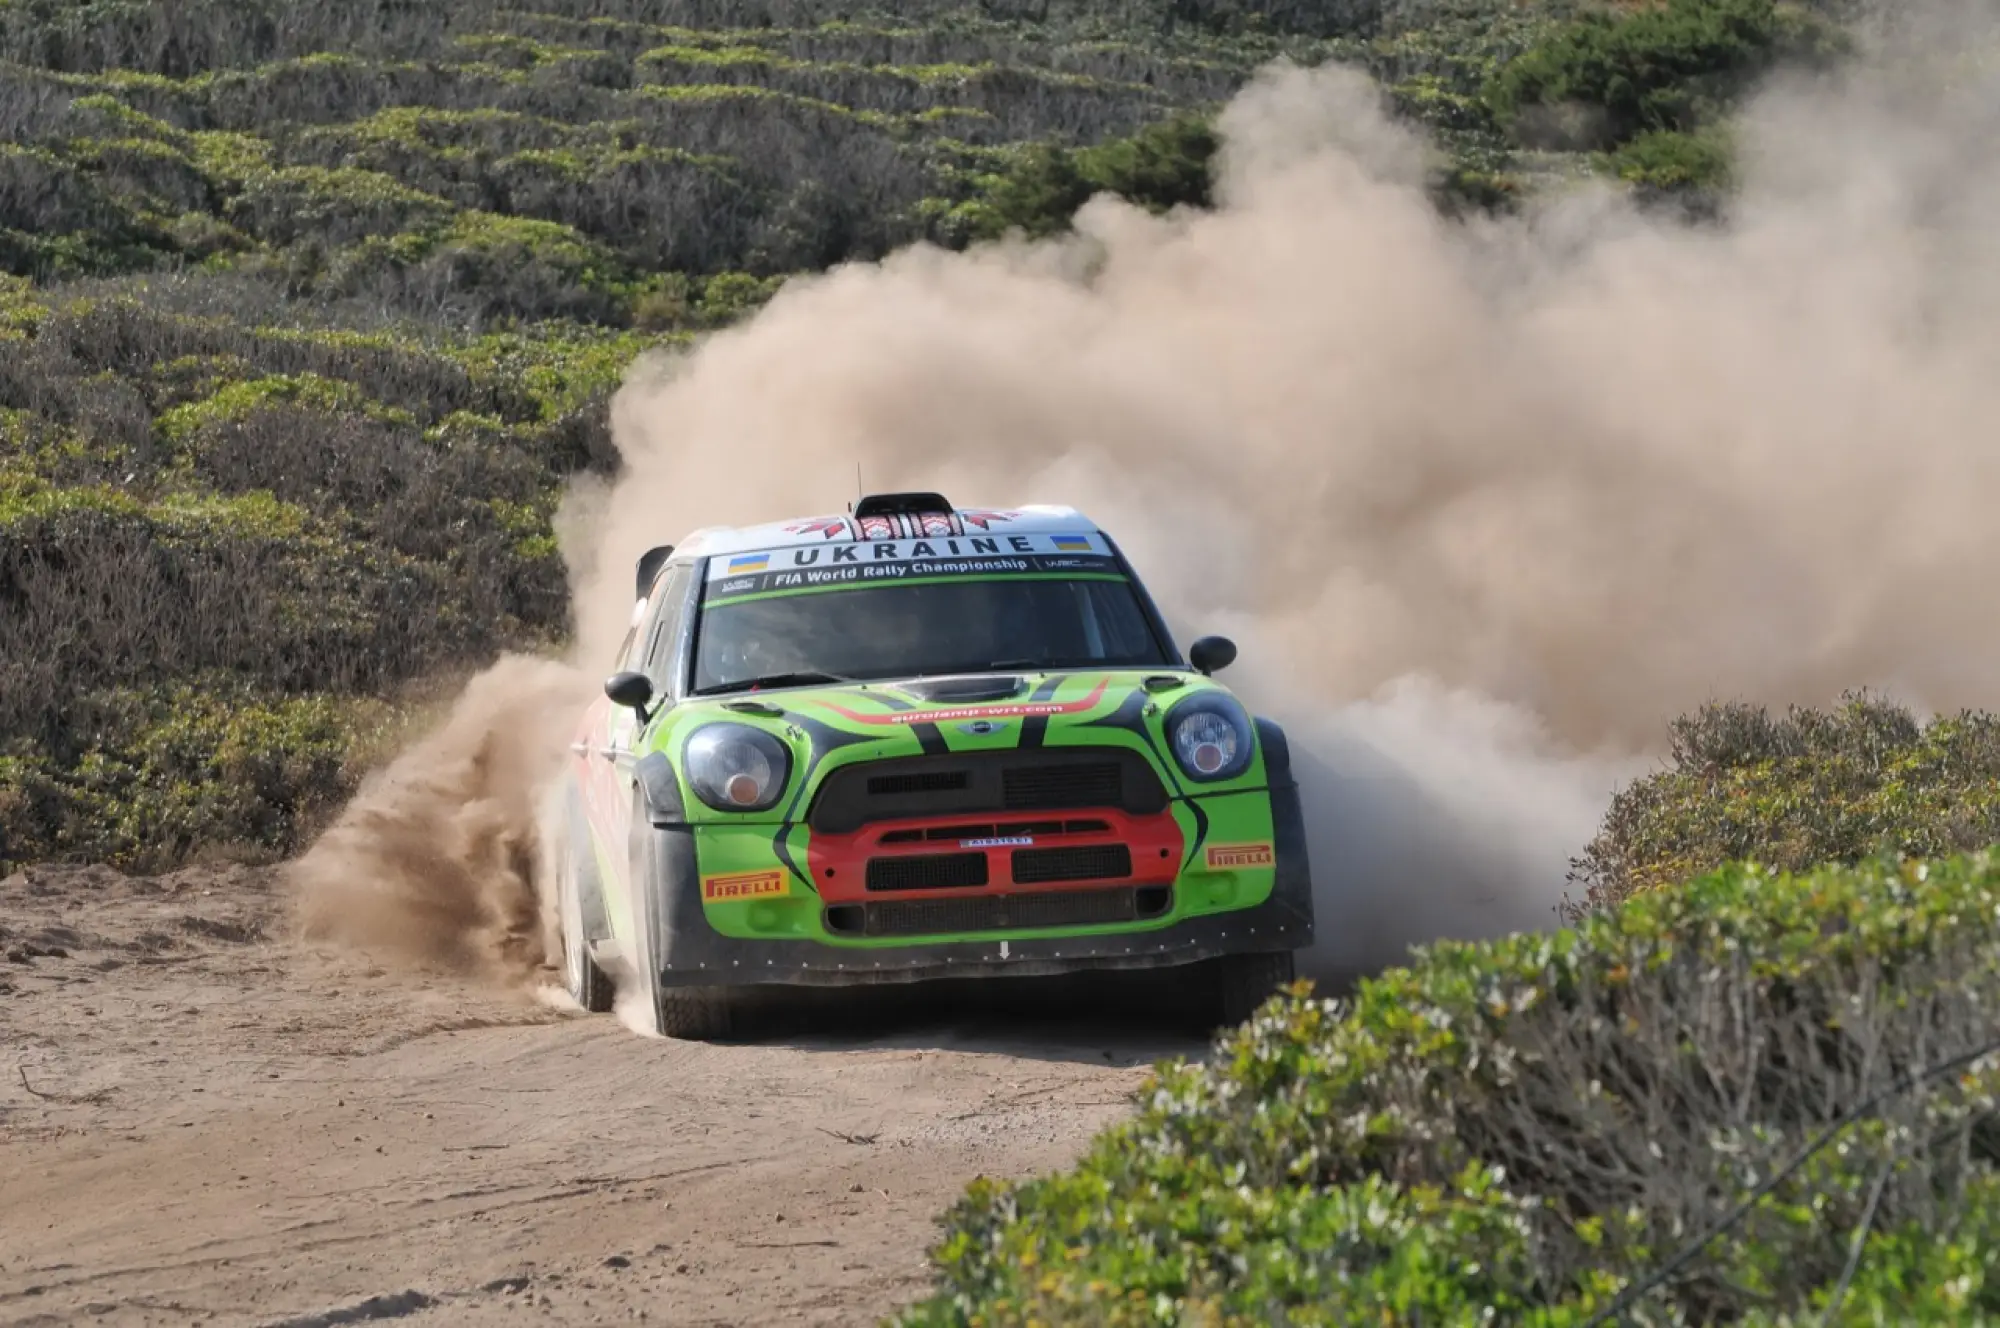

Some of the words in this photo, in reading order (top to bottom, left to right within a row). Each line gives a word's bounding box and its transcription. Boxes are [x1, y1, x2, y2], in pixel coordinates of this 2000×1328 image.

[794, 536, 1035, 565] UKRAINE
[775, 573, 802, 586] FIA
[807, 568, 857, 583] World
[864, 561, 907, 577] Rally
[912, 553, 1028, 573] Championship
[1208, 845, 1271, 866] PIRELLI
[706, 872, 781, 898] PIRELLI
